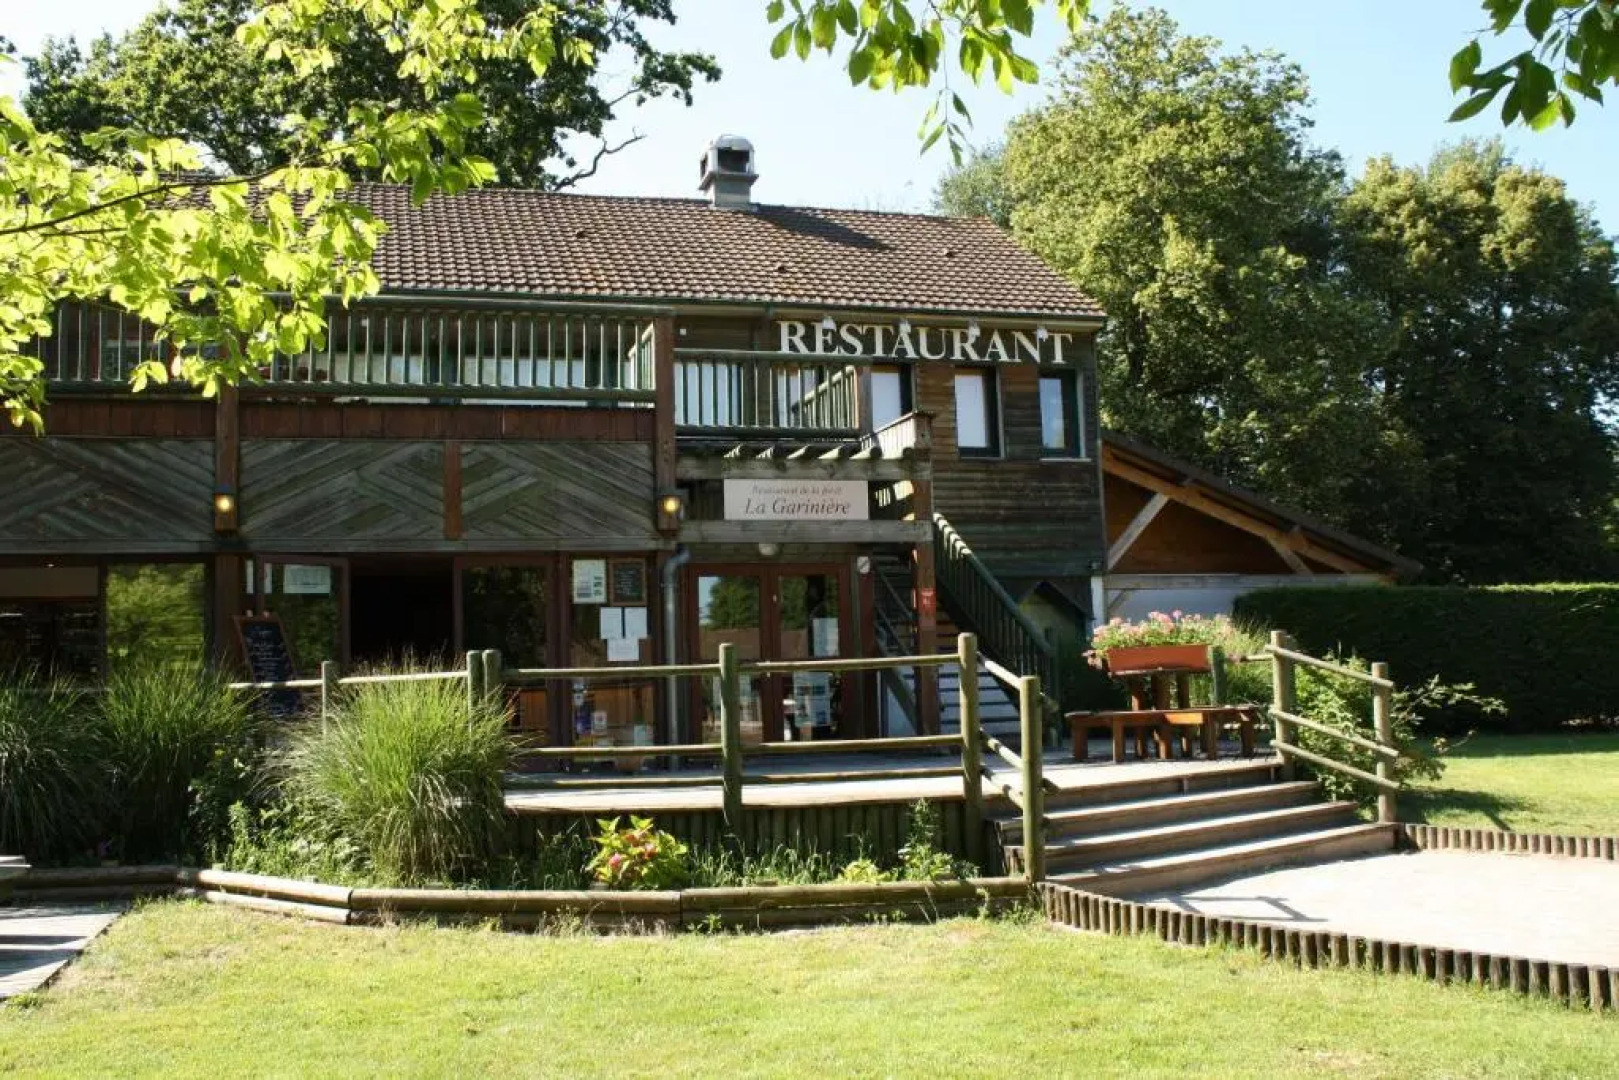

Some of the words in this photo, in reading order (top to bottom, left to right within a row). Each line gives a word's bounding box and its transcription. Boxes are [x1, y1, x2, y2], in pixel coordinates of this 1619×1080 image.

[776, 319, 1073, 364] RESTAURANT
[745, 498, 765, 515] La
[772, 498, 851, 515] Garinière
